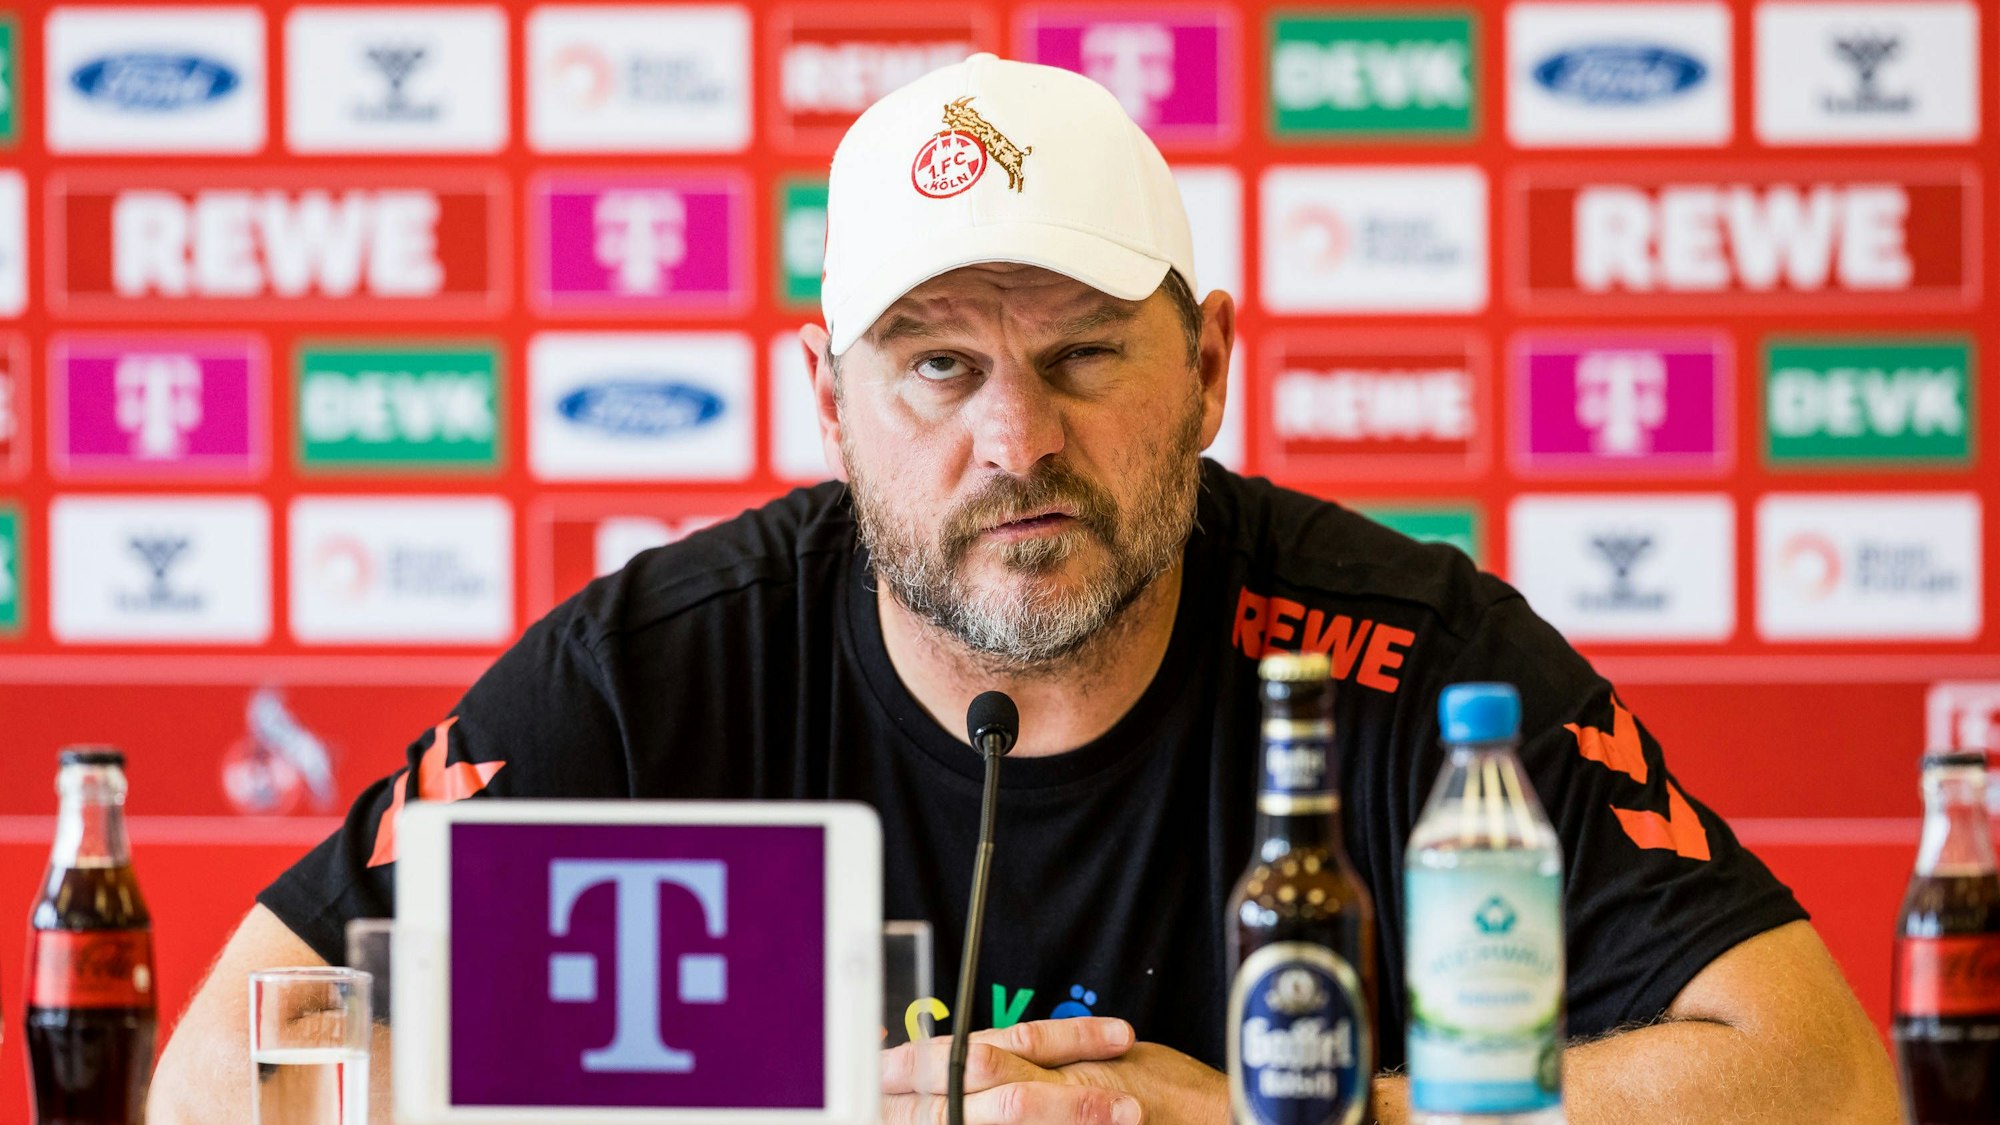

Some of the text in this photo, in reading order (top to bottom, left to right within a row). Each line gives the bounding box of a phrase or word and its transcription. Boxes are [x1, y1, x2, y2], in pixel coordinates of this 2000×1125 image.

[1272, 40, 1470, 110] DEVK
[930, 173, 969, 191] KÖLN
[113, 189, 443, 295] REWE
[1573, 183, 1912, 291] REWE
[302, 370, 496, 441] DEVK
[1274, 368, 1475, 440] REWE
[1769, 366, 1964, 437] DEVK
[1232, 585, 1415, 693] REWE
[548, 858, 728, 1074] T
